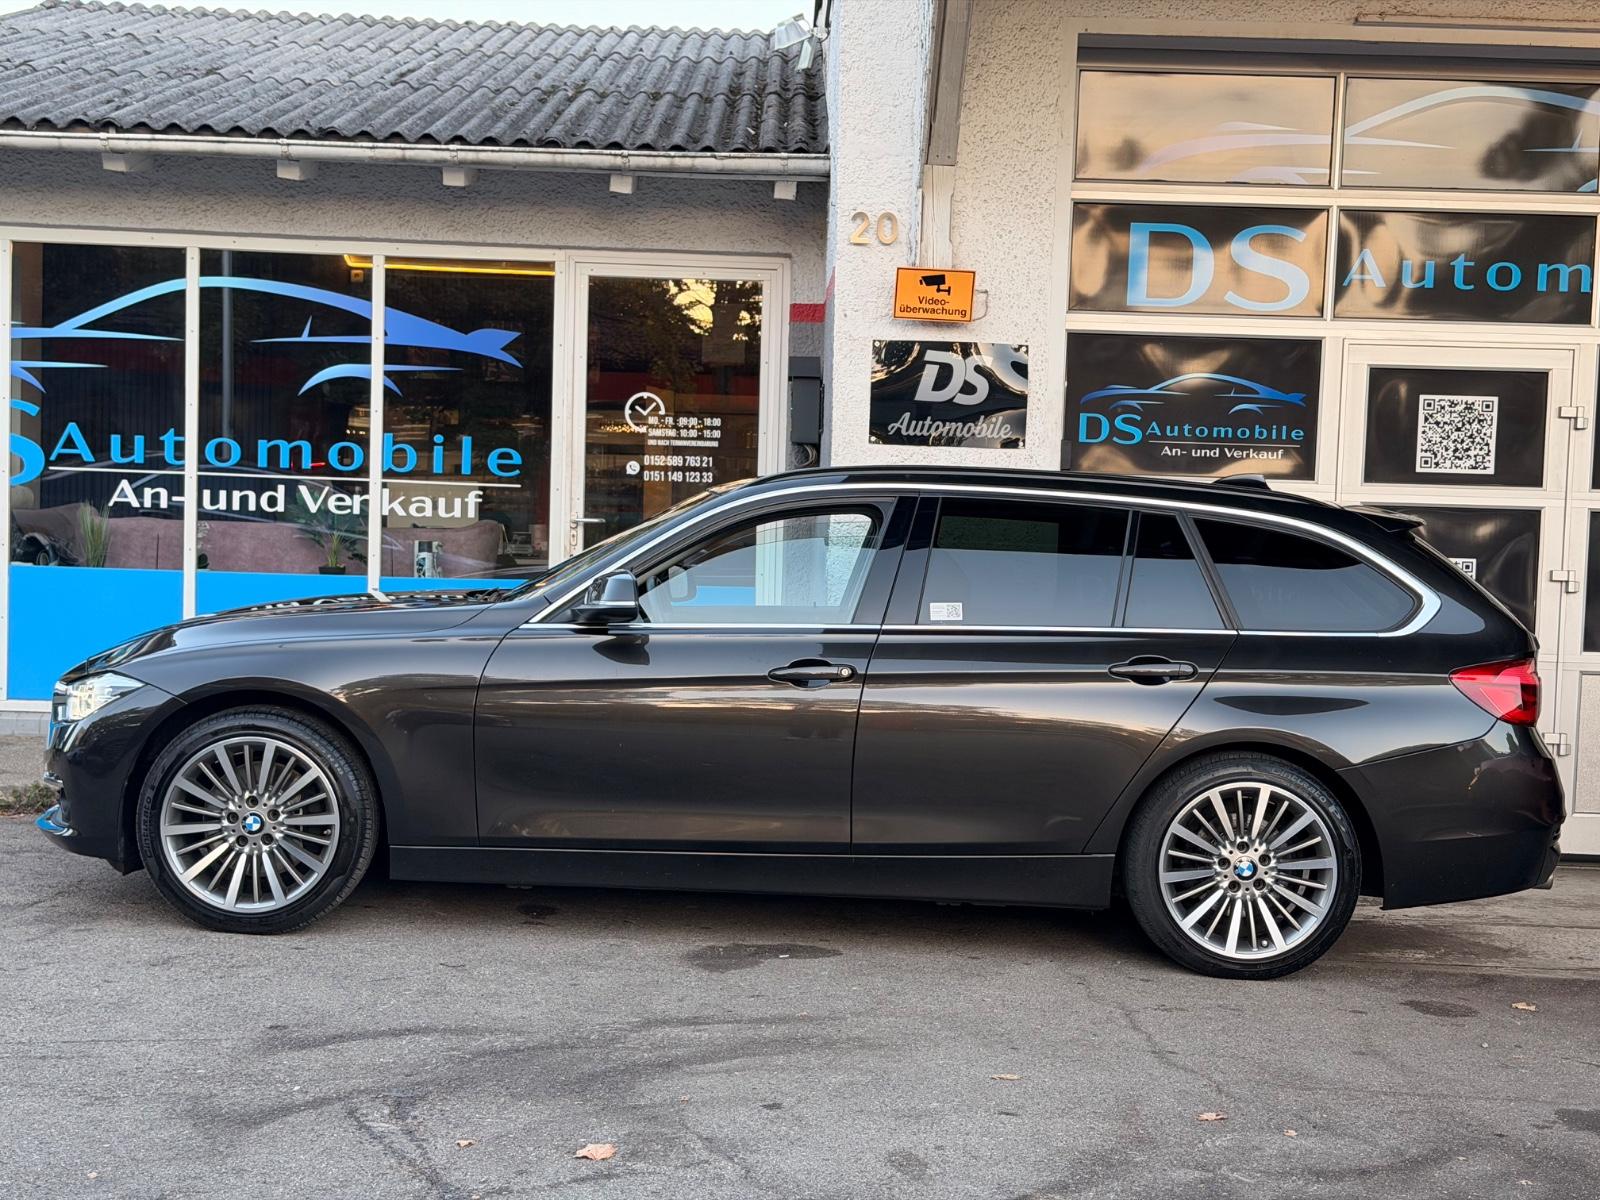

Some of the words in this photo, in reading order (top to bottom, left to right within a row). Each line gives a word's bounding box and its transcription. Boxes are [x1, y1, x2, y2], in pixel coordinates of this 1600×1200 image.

[850, 211, 898, 246] 20
[1126, 222, 1310, 312] DS
[1343, 248, 1592, 293] Autom
[899, 304, 967, 318] überwachung
[918, 296, 950, 306] Video-
[914, 349, 990, 406] DS
[888, 411, 1013, 439] Automobile
[1078, 412, 1143, 445] DS
[1145, 421, 1305, 441] Automobile
[49, 421, 524, 478] Automobile
[644, 455, 665, 466] 0152
[667, 455, 683, 466] 589
[685, 456, 701, 467] 763
[702, 456, 713, 467] 21
[1161, 446, 1187, 457] An-
[1192, 447, 1219, 458] und
[1224, 448, 1284, 460] Verkauf
[643, 471, 665, 481] 0151
[667, 471, 683, 482] 149
[685, 472, 700, 483] 123
[702, 472, 713, 483] 33
[108, 478, 186, 509] An-
[202, 484, 287, 513] und
[297, 484, 484, 519] Verkauf
